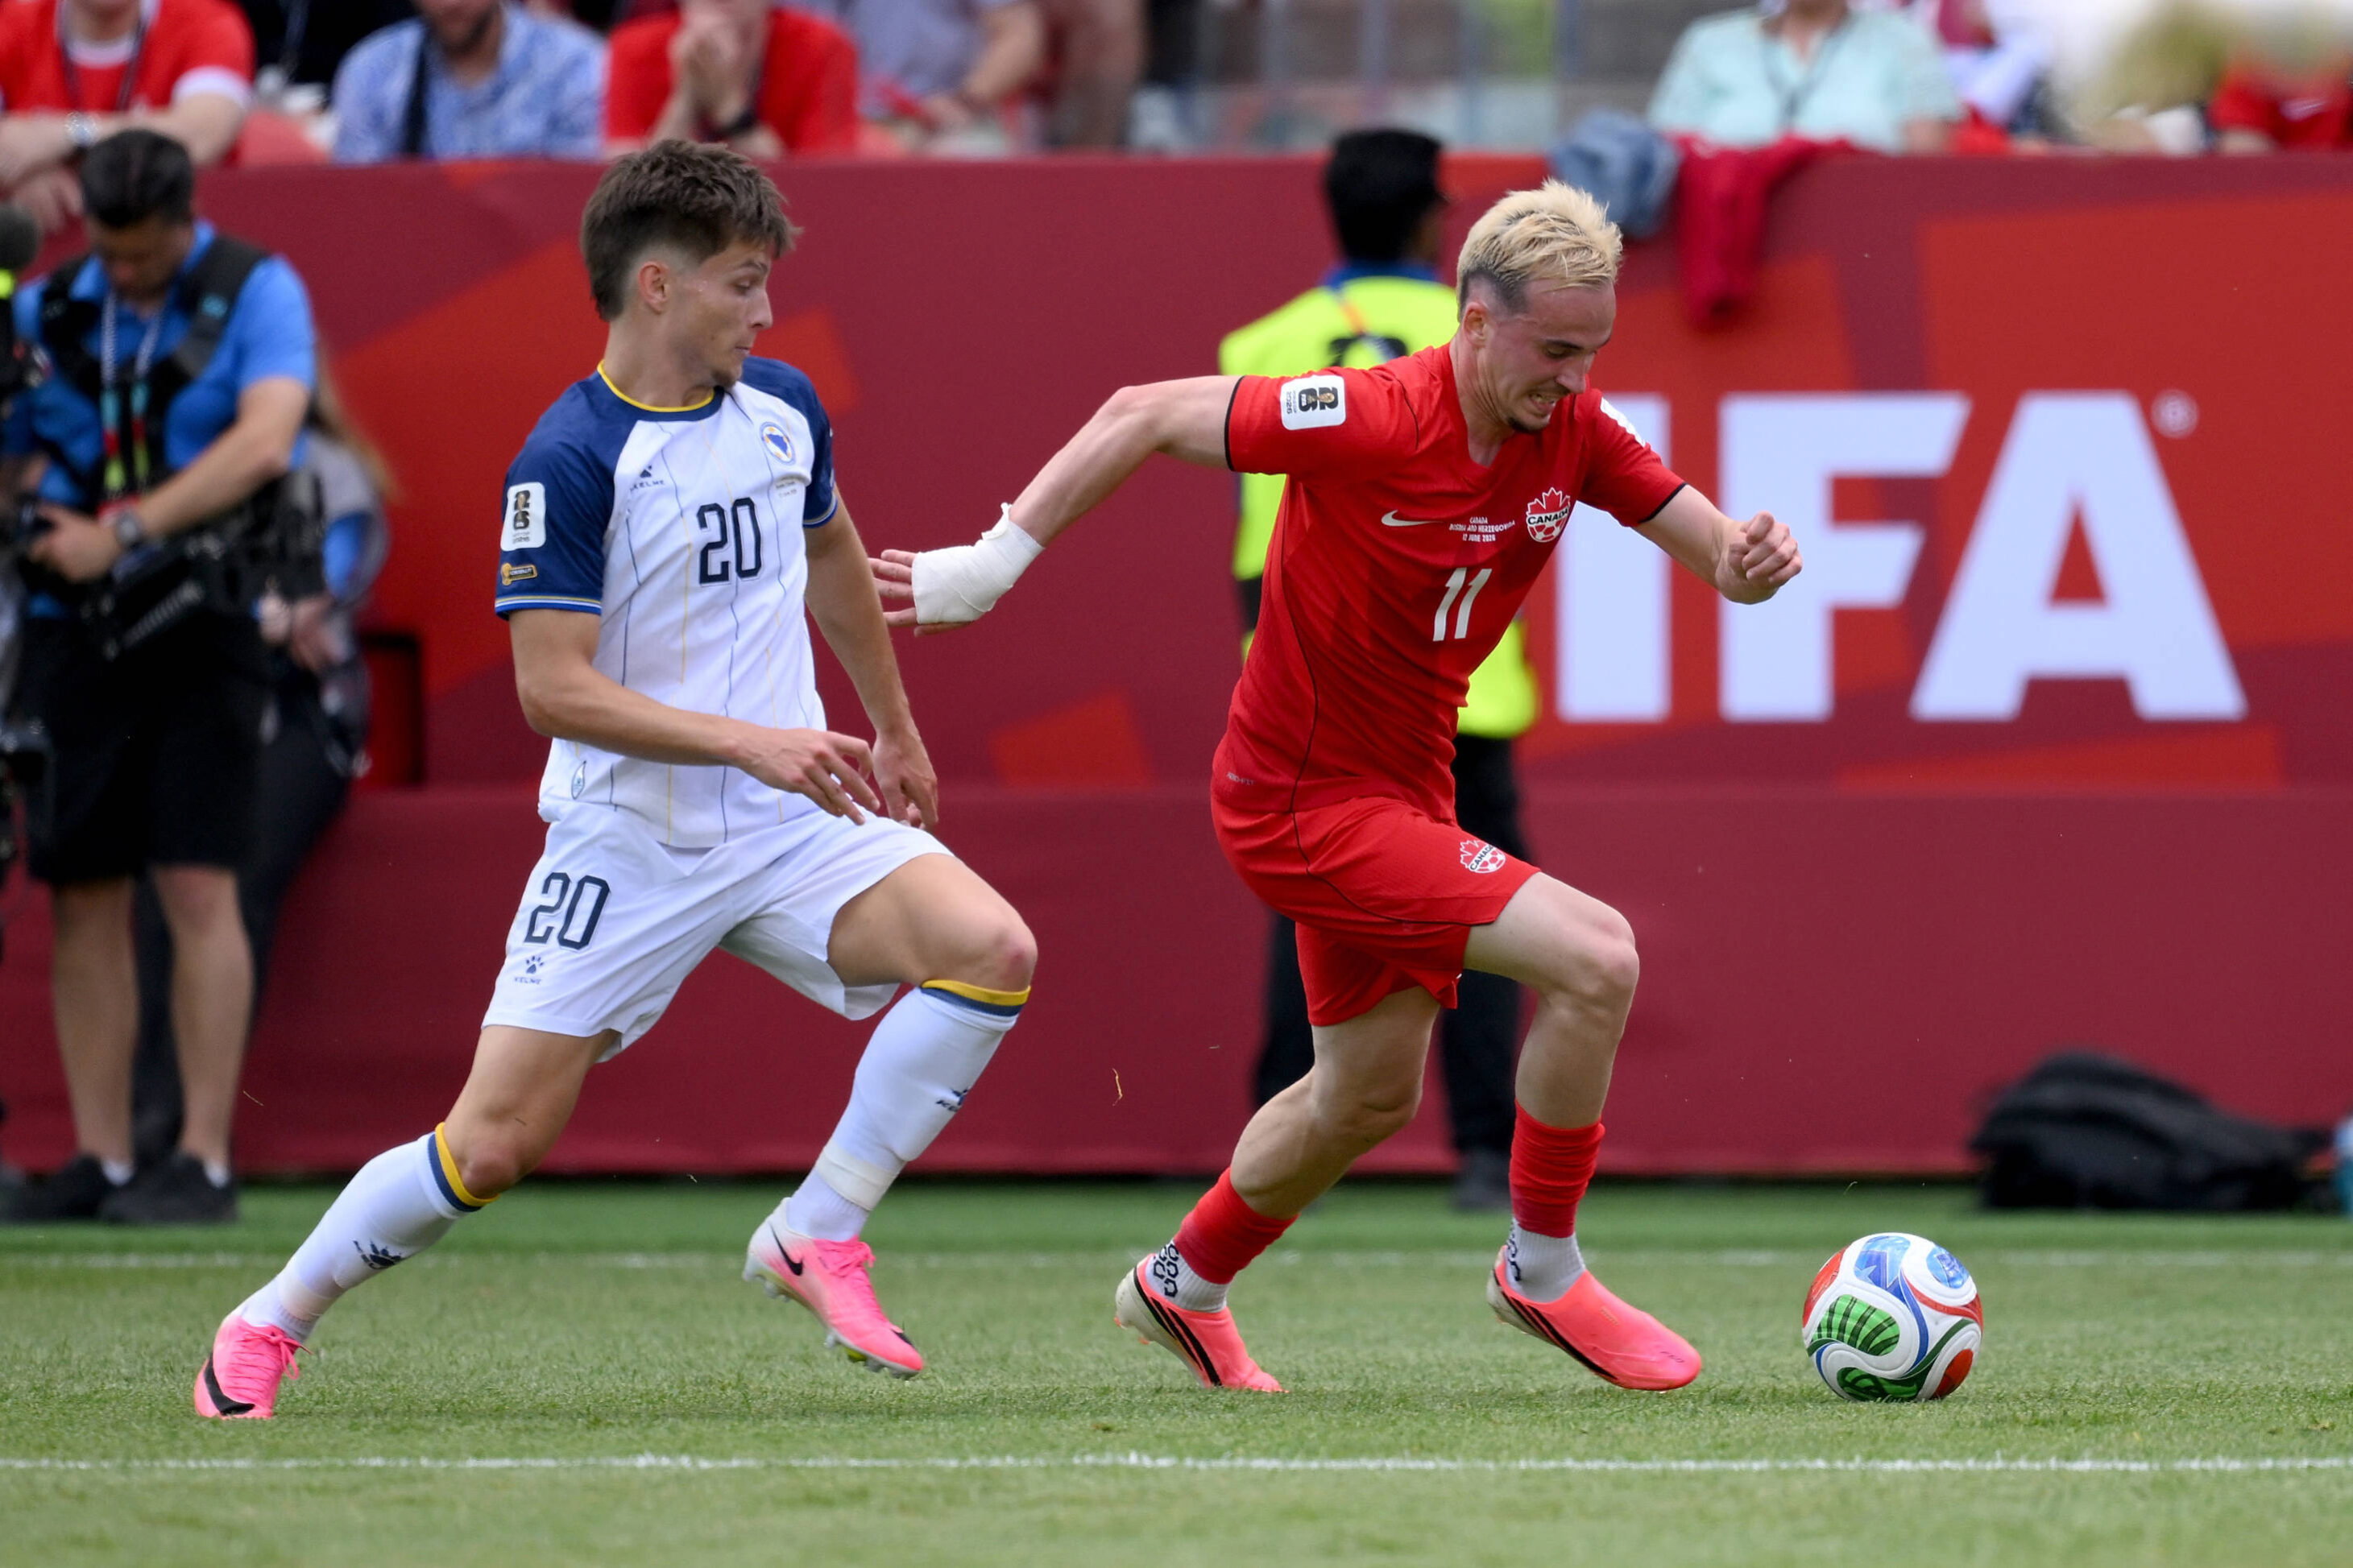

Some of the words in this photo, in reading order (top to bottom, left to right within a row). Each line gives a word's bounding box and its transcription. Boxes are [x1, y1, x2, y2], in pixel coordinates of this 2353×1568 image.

[696, 496, 762, 585] 20
[1469, 516, 1489, 524] CANADA
[1527, 507, 1568, 525] CANADA
[1556, 392, 2248, 722] IFA
[1432, 567, 1493, 642] 11
[524, 872, 611, 950] 20
